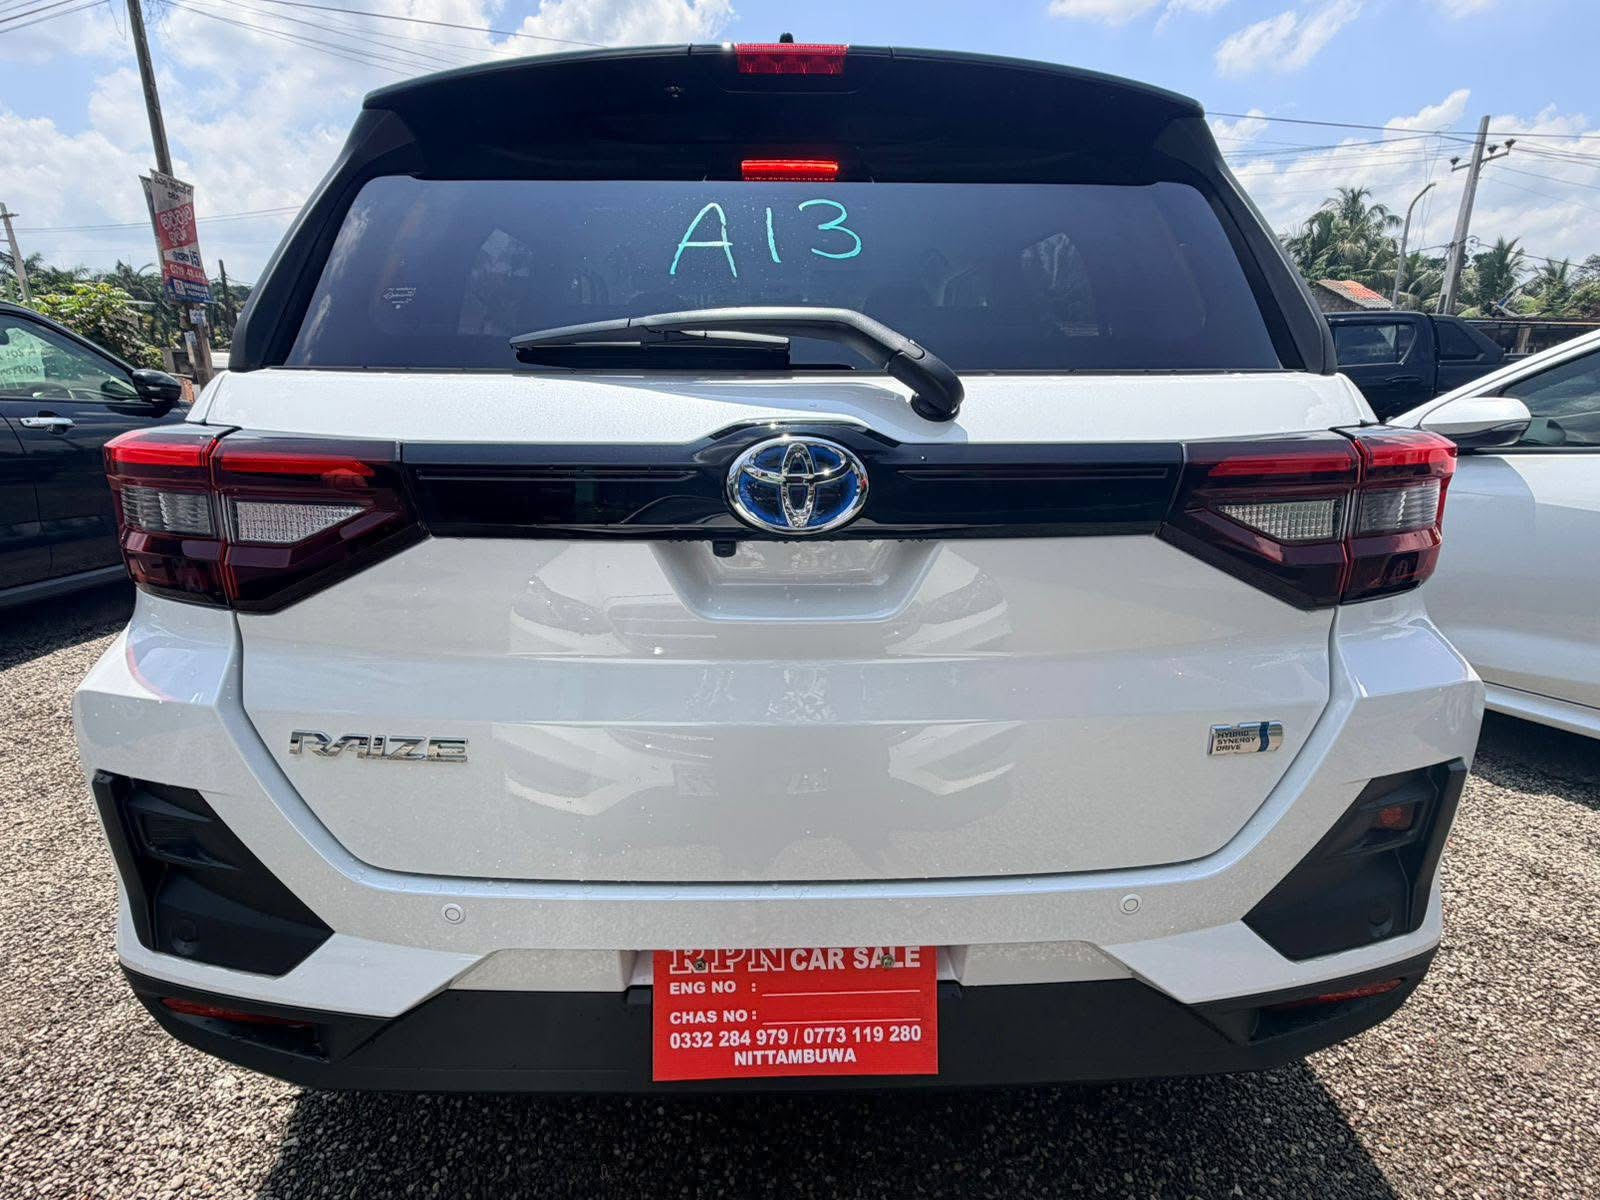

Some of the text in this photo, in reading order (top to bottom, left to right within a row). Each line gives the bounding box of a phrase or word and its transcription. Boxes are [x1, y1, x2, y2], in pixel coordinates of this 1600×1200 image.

[670, 199, 862, 277] A13
[1216, 730, 1249, 738] HYBRID
[1216, 736, 1256, 745] SYNERGY
[288, 728, 468, 763] RAIZE
[1215, 744, 1241, 752] DRIVE
[668, 946, 921, 974] RPN CAR SALE
[669, 982, 706, 995] ENG
[711, 980, 737, 994] NO
[669, 1010, 718, 1025] CHAS
[669, 1031, 714, 1049] 0332
[718, 1029, 751, 1047] 284
[755, 1028, 789, 1046] 979
[803, 1026, 847, 1044] 0773
[852, 1025, 884, 1043] 119
[889, 1025, 922, 1042] 280
[734, 1048, 857, 1066] NITTAMBUWA
